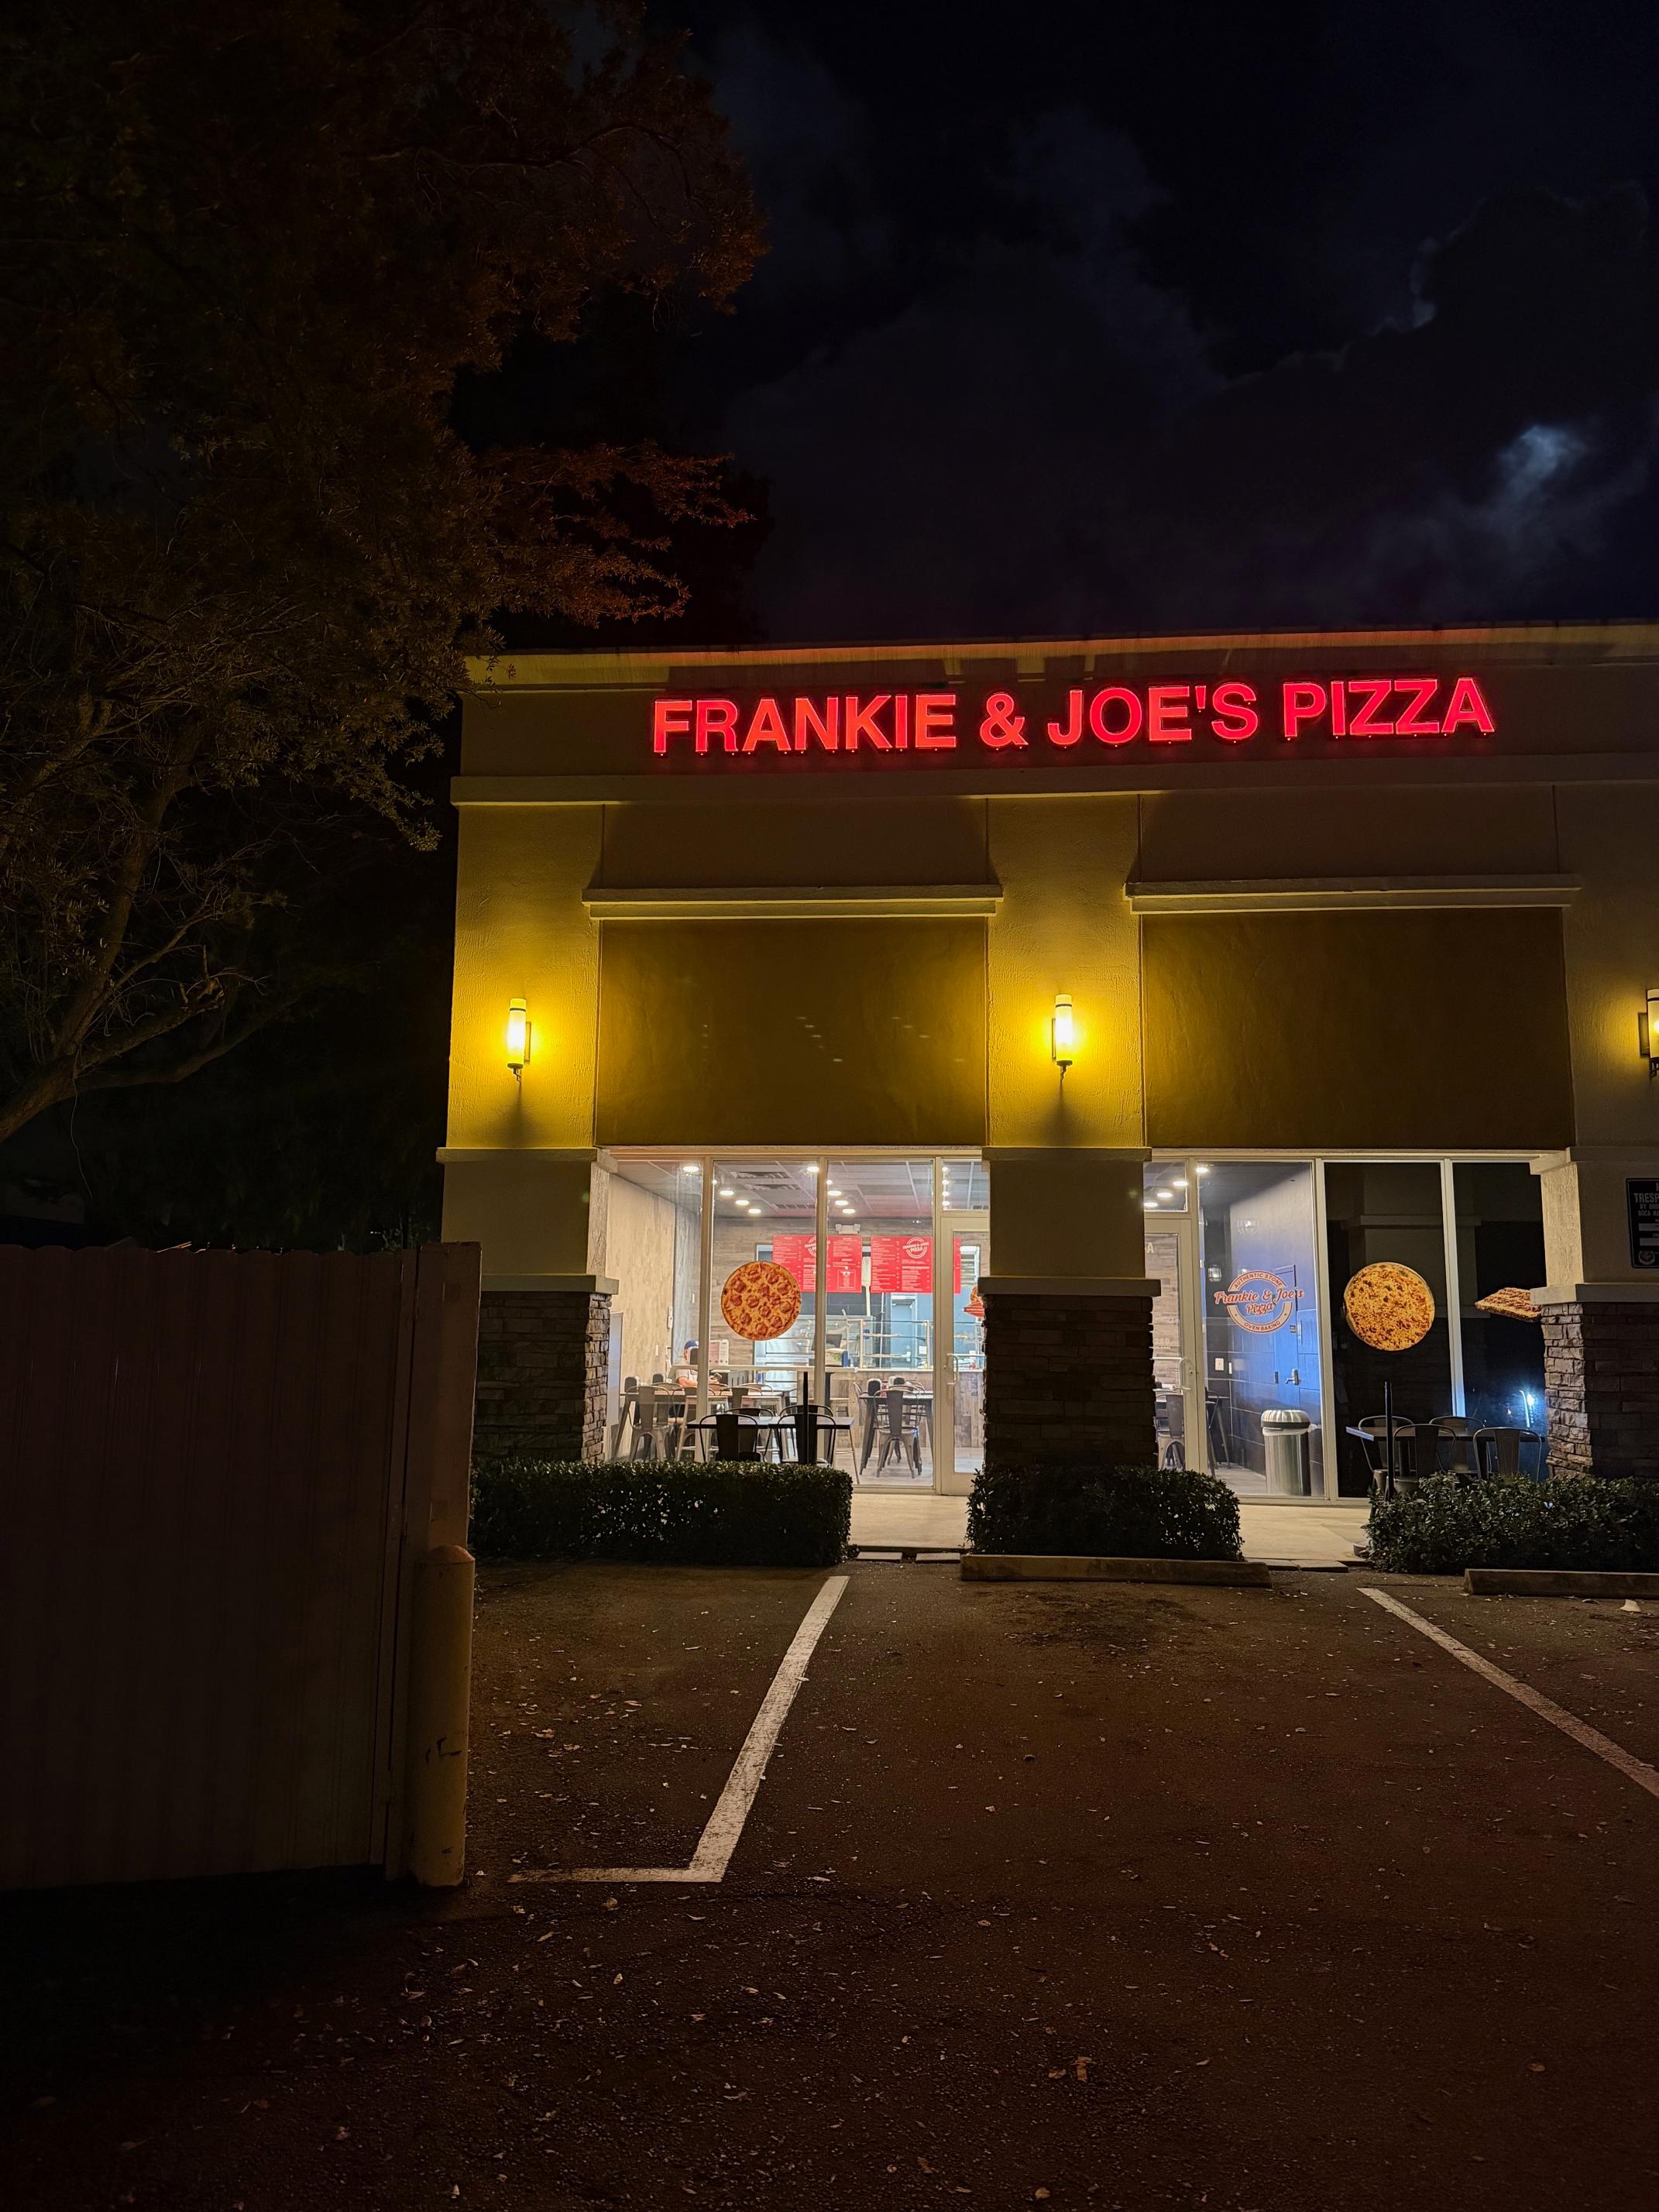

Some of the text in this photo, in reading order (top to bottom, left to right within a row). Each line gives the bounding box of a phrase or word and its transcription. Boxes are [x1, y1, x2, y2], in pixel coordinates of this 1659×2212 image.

[654, 677, 1495, 754] FRANKIE & JOE'S PIZZA
[1235, 1272, 1283, 1289] AUTHENTIC STONE
[1214, 1290, 1259, 1305] Frankie
[1262, 1289, 1273, 1301] &
[1245, 1302, 1275, 1316] Pizza
[1243, 1321, 1281, 1331] OVEN BAKING
